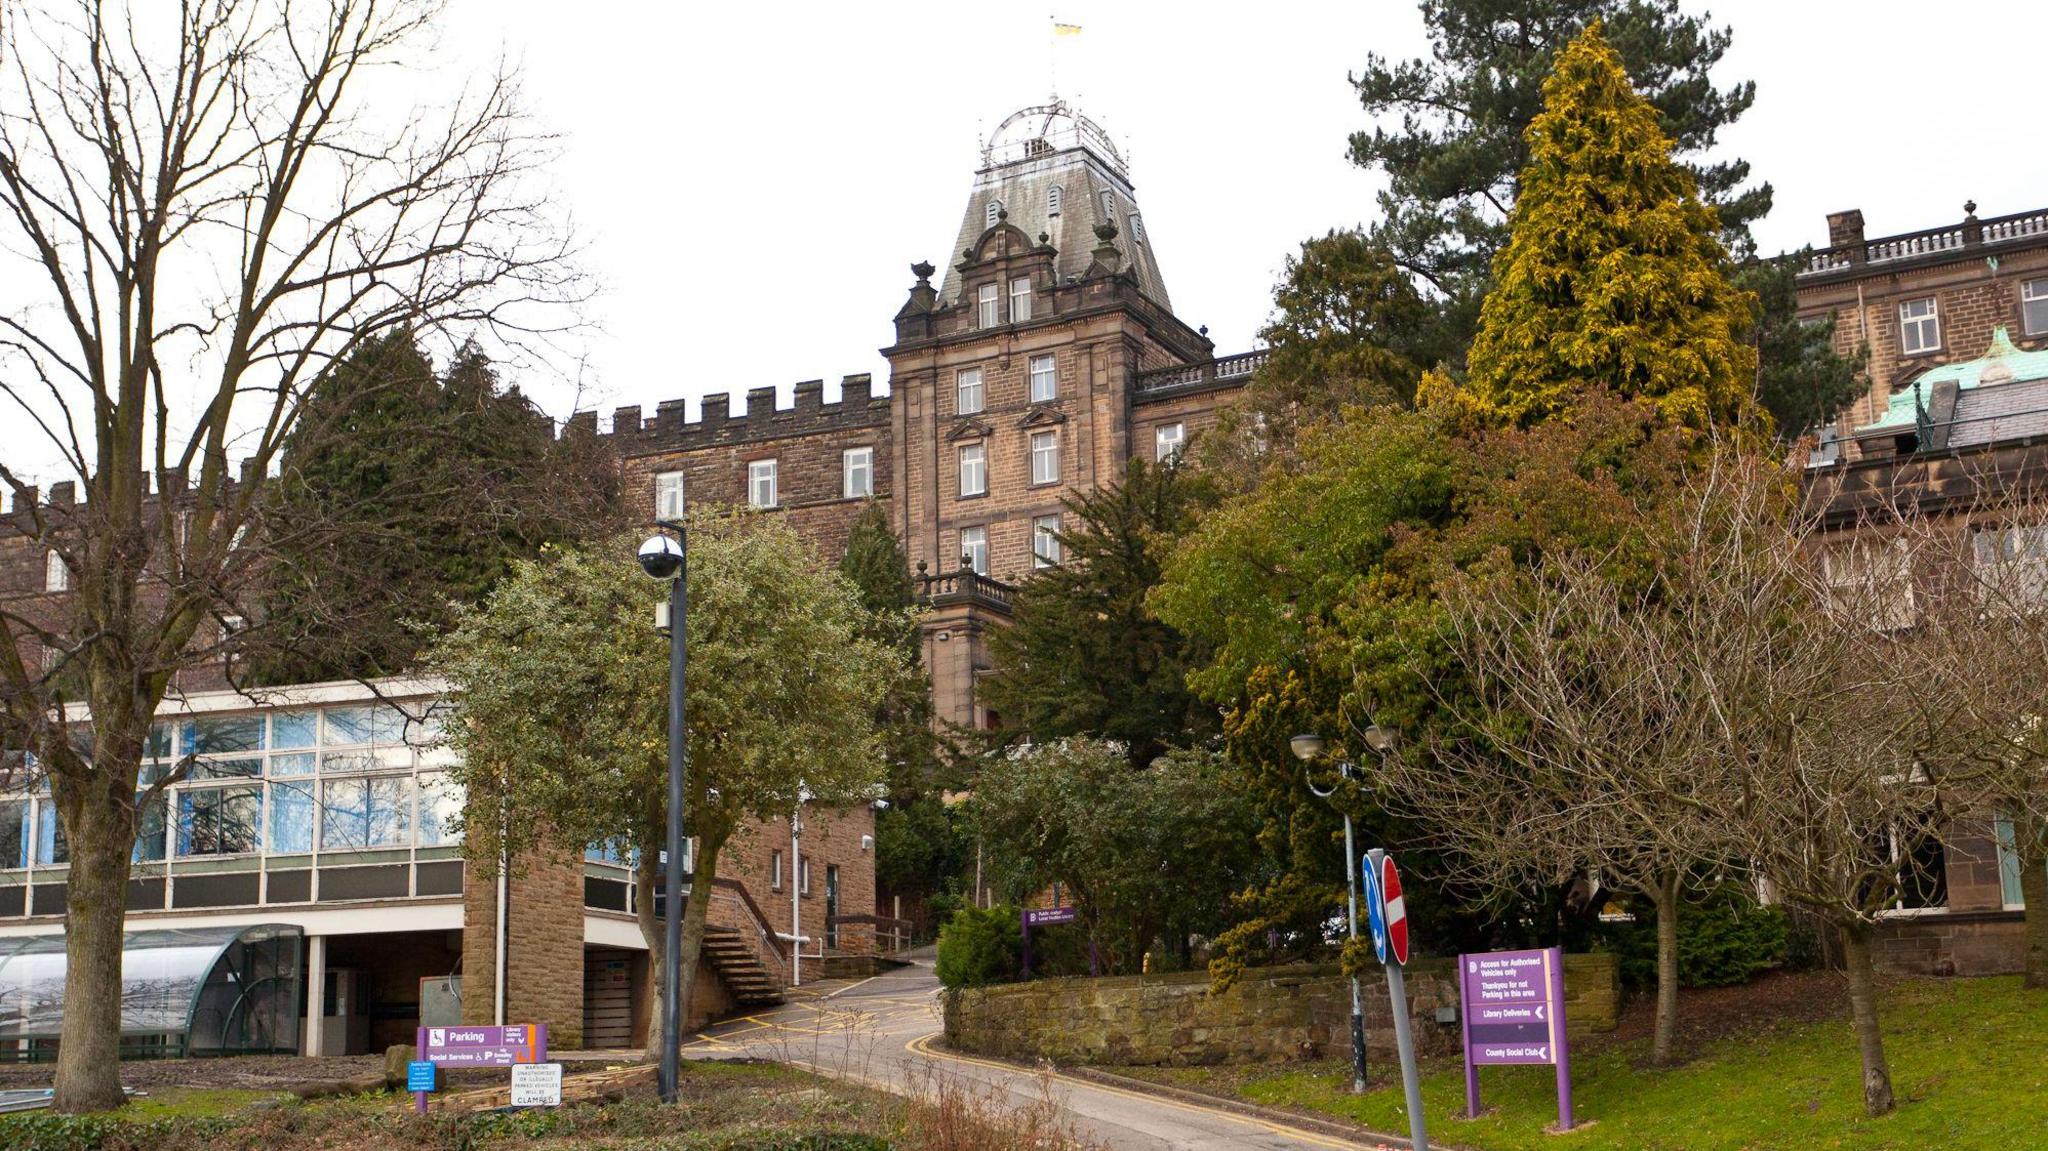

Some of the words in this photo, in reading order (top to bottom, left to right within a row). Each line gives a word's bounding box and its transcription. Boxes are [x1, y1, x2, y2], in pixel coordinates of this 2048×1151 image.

[1480, 960, 1500, 968] Access
[1511, 958, 1540, 966] Authorised
[1505, 968, 1516, 977] only
[1482, 982, 1508, 990] Thankyou
[1482, 990, 1503, 999] Parking
[1483, 1010, 1502, 1019] Library
[450, 1032, 484, 1043] Parking
[1486, 1049, 1505, 1058] County
[1525, 1048, 1538, 1056] Club
